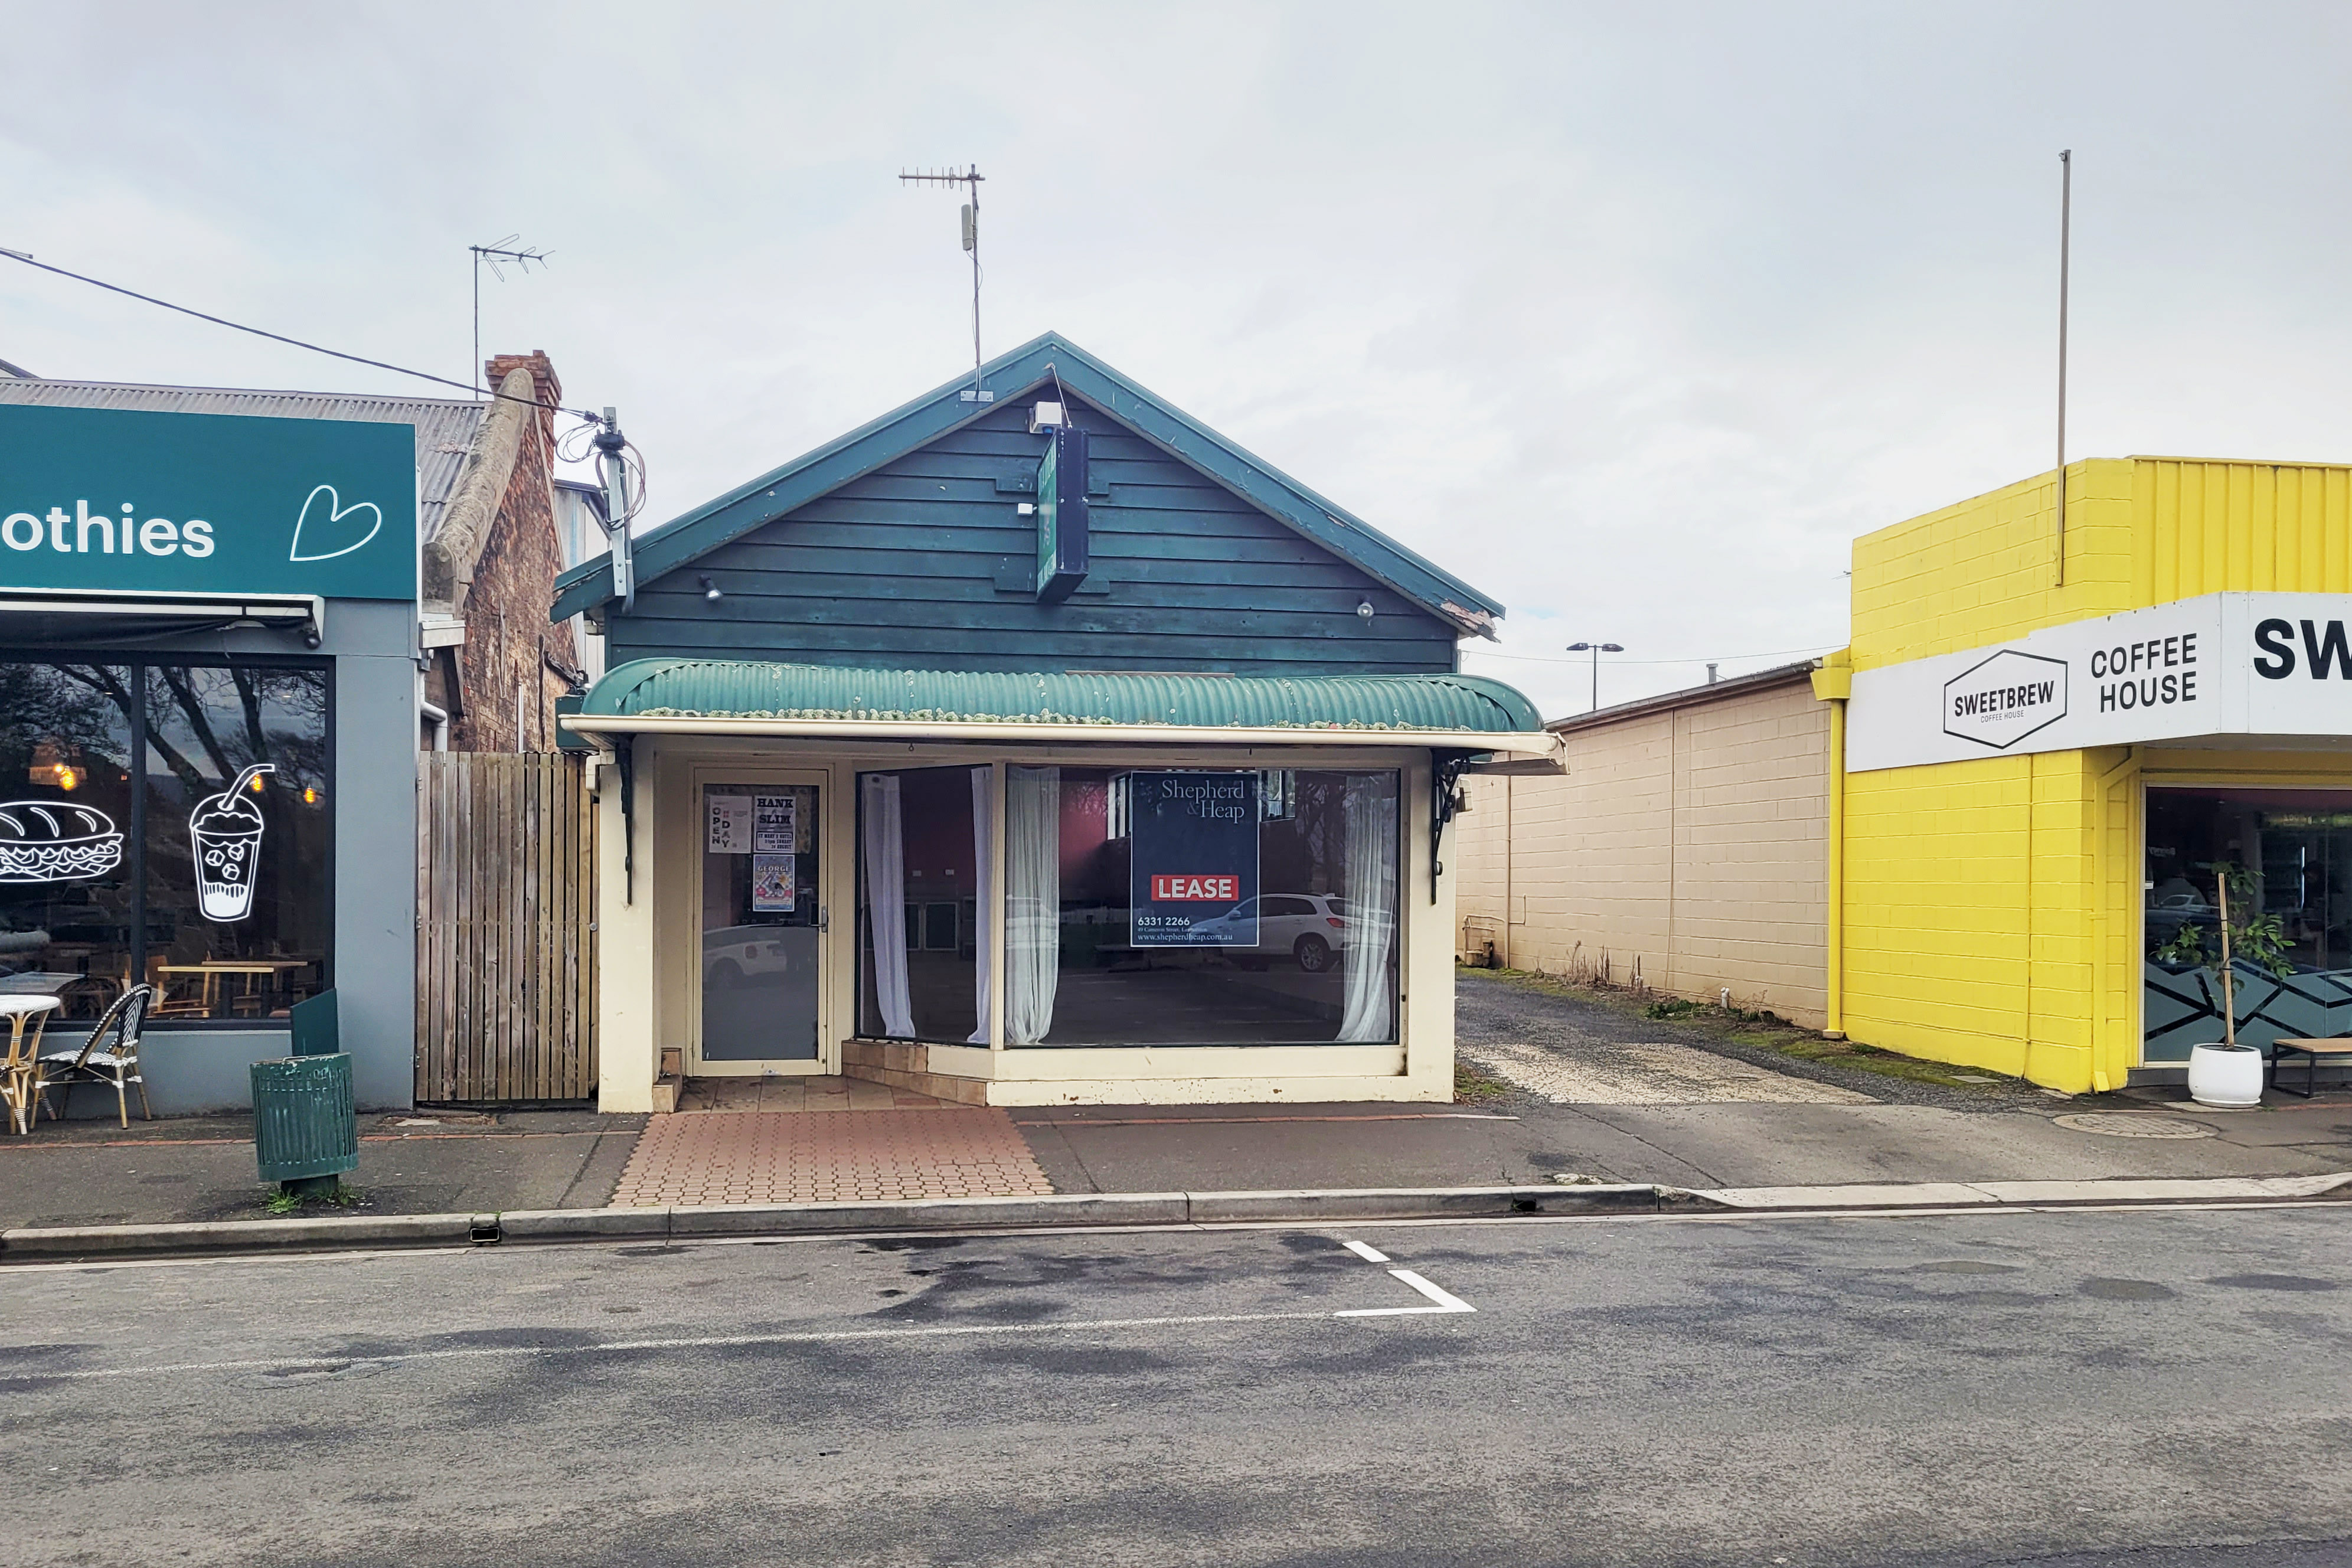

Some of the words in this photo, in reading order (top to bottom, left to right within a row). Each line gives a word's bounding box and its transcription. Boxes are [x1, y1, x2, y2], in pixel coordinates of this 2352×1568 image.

[2, 499, 215, 558] othies
[2090, 632, 2197, 679] COFFEE
[1954, 680, 2054, 717] SWEETBREW
[2100, 671, 2197, 713] HOUSE
[1981, 713, 2003, 723] COFFEE
[2004, 710, 2024, 720] HOUSE
[1162, 779, 1245, 804] Shepherd
[757, 798, 793, 808] HANK
[1200, 800, 1245, 824] Heap
[759, 815, 791, 824] SLIM
[1158, 878, 1232, 899] LEASE
[1138, 917, 1161, 926] 6331
[1165, 917, 1190, 926] 2266
[1138, 933, 1233, 942] www.shepherdheap.com.au
